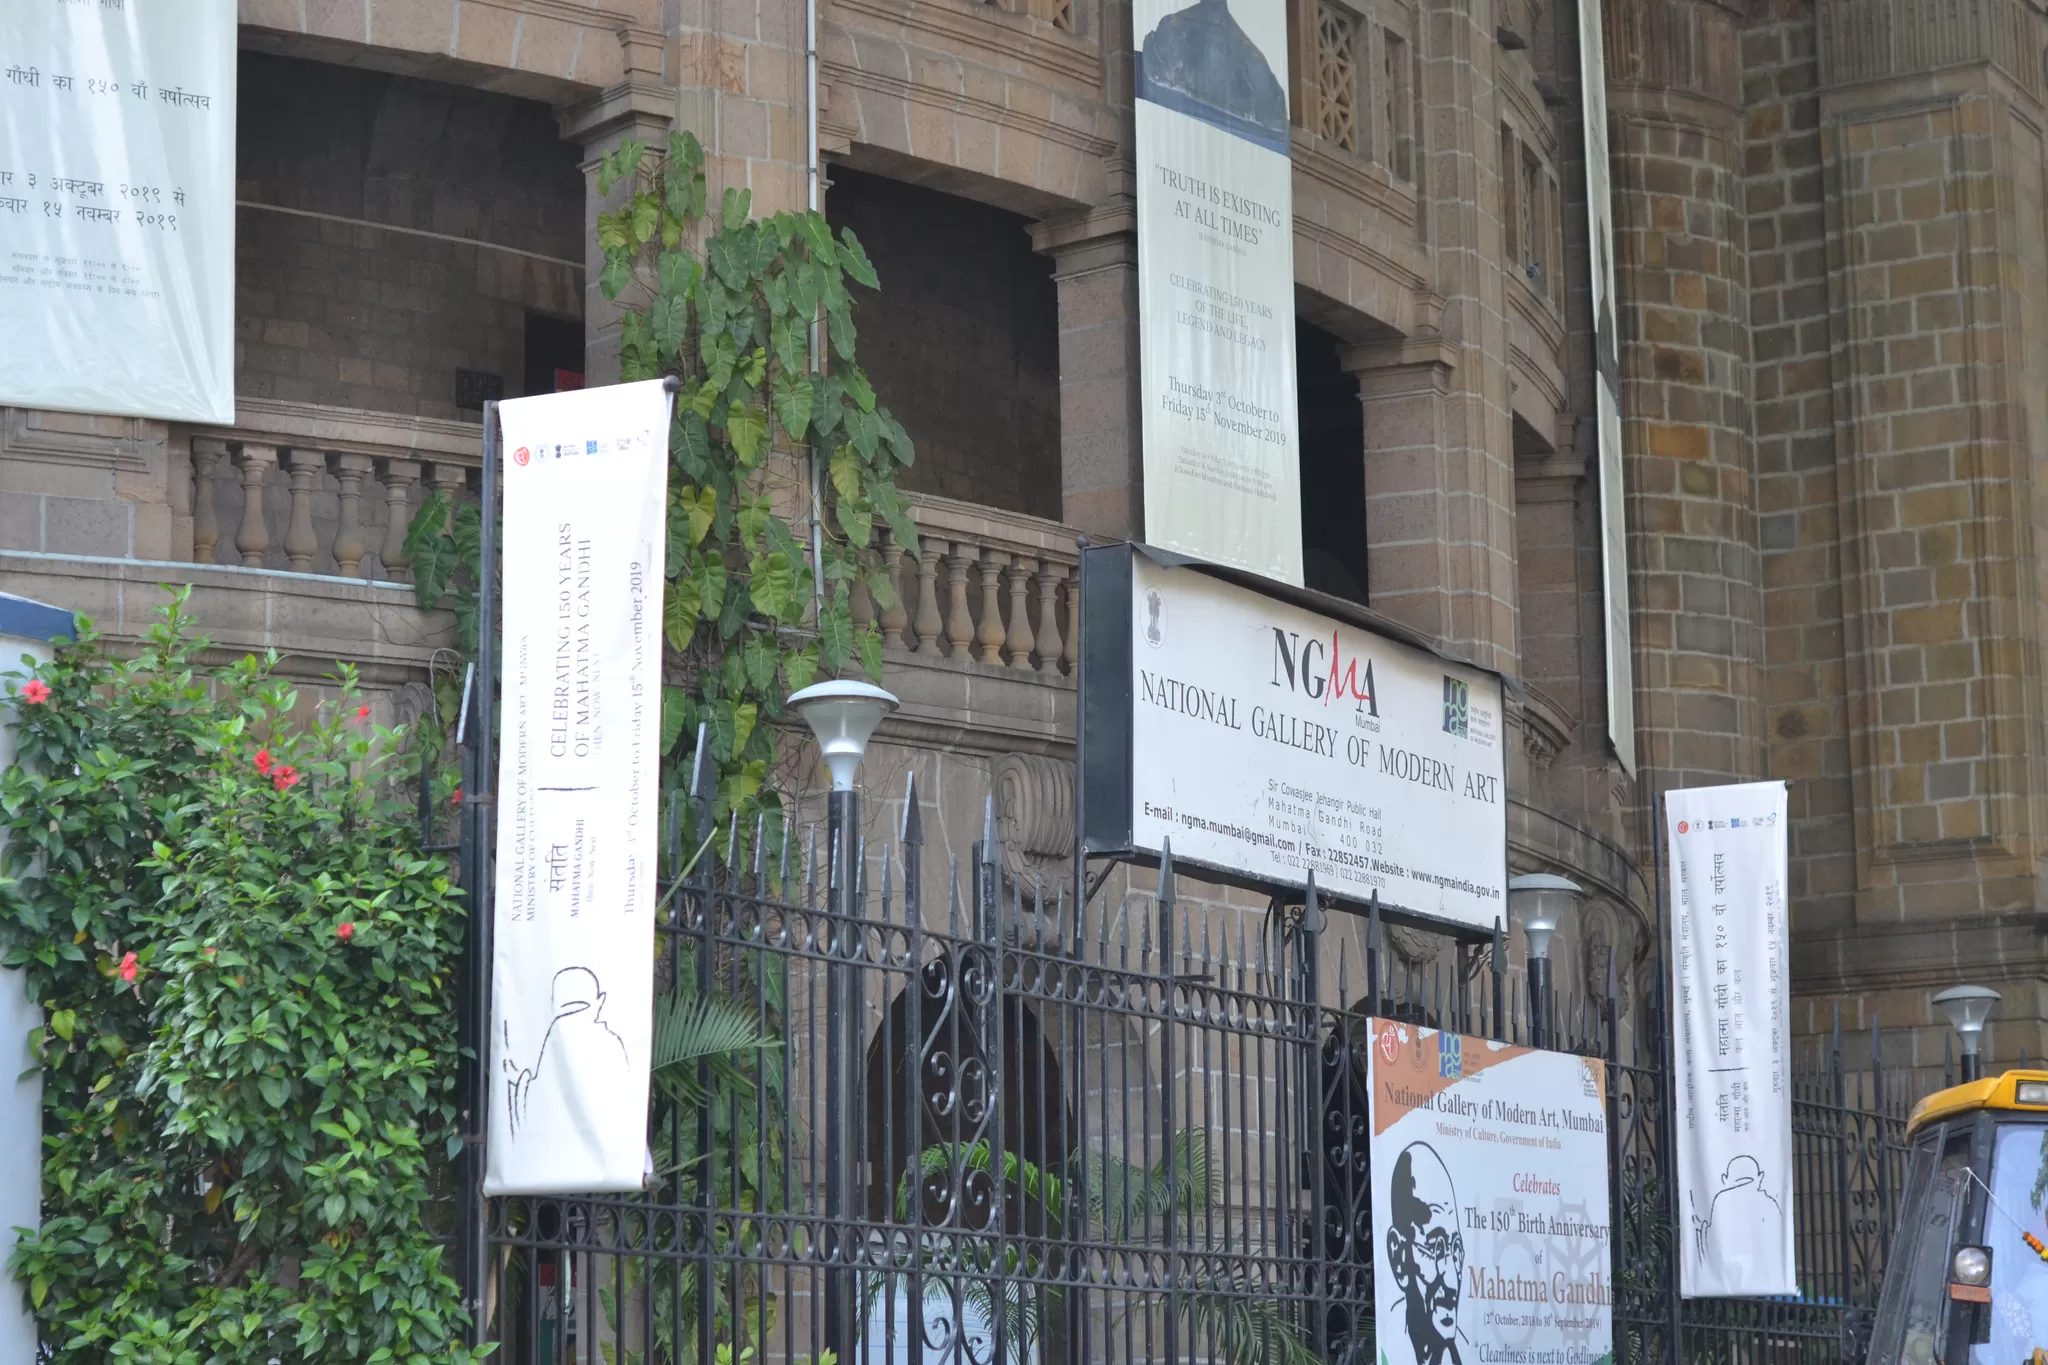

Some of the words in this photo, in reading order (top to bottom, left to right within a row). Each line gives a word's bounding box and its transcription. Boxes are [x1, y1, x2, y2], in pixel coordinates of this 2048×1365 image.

[52, 75, 73, 92] का
[88, 78, 119, 96] १५०
[131, 80, 149, 100] वाँ
[28, 172, 37, 190] ३
[50, 177, 105, 199] अक्टूबर
[120, 183, 161, 204] २०१९
[173, 187, 186, 208] से
[1209, 184, 1220, 205] IS
[1223, 190, 1281, 228] EXISTING
[43, 200, 62, 218] १५
[76, 205, 121, 225] नवम्बर
[136, 210, 177, 231] २०१९
[1174, 200, 1191, 219] AT
[1194, 207, 1218, 231] ALL
[1169, 273, 1229, 304] CELEBRATING
[1229, 294, 1244, 309] 150
[1245, 299, 1273, 320] YEARS
[1195, 300, 1207, 313] OF
[1209, 304, 1226, 321] THE
[1176, 310, 1213, 333] LEGEND
[1214, 324, 1233, 341] AND
[1233, 332, 1267, 352] LEGACY
[1168, 376, 1213, 406] Thursday
[1228, 395, 1268, 420] October
[1269, 410, 1280, 423] to
[1162, 394, 1193, 421] Friday
[1213, 411, 1262, 440] November
[1265, 428, 1287, 446] 2019
[558, 523, 572, 586] YEARS
[577, 540, 591, 618] GANDHI
[629, 561, 643, 594] 2019
[558, 591, 571, 619] 150
[630, 598, 643, 672] November
[550, 626, 571, 758] CELEBRATING
[576, 623, 590, 725] MAHATMA
[631, 700, 642, 747] Friday
[1140, 669, 1241, 730] NATIONAL
[1252, 705, 1338, 758] GALLERY
[1347, 734, 1370, 768] OF
[1379, 744, 1455, 793] MODERN
[1463, 770, 1497, 804] ART
[1355, 714, 1381, 733] Mumbai
[517, 721, 528, 775] MODERN
[574, 731, 590, 757] OF
[631, 749, 641, 765] to
[517, 778, 527, 796] OF
[628, 767, 640, 826] October
[1268, 778, 1278, 792] Sir
[1281, 782, 1312, 803] Cowasjee
[1316, 792, 1343, 811] Jehangir
[1347, 800, 1366, 816] Public
[1369, 807, 1382, 820] Hall
[515, 800, 527, 855] GALLERY
[1268, 797, 1310, 819] Mahatma
[1318, 809, 1352, 829] Gandhi
[1360, 821, 1382, 837] Road
[1268, 815, 1306, 835] Mumbai
[1340, 834, 1357, 848] 400
[1366, 840, 1382, 855] 032
[528, 844, 536, 861] OF
[573, 819, 585, 861] GANDHI
[1145, 801, 1172, 822] E-mail
[1181, 812, 1295, 852] ngma.mumbai@gmail.com
[1305, 842, 1321, 858] Fax
[1411, 868, 1500, 899] www.ngmaindia.gov.in
[544, 843, 569, 893] संतति
[624, 853, 637, 916] Thursday
[1271, 850, 1281, 862] Tel
[1287, 855, 1300, 868] 022
[1340, 868, 1353, 881] 022
[1354, 869, 1386, 889] 22881970
[511, 860, 526, 922] NATIONAL
[526, 865, 536, 922] MINISTRY
[570, 863, 583, 918] MAHATMA
[1715, 924, 1728, 949] १५०
[1715, 959, 1728, 975] का
[1733, 969, 1743, 985] कल
[1731, 991, 1744, 1005] और
[1718, 1018, 1731, 1056] महात्मा
[1733, 1012, 1744, 1031] आज
[1733, 1038, 1744, 1054] कल
[1384, 1081, 1434, 1111] National
[1437, 1091, 1479, 1123] Gallery
[1482, 1099, 1494, 1118] of
[1495, 1100, 1536, 1126] Modern
[1540, 1107, 1560, 1130] Art,
[1562, 1109, 1604, 1134] Mumbai
[1714, 1093, 1730, 1123] संतति
[1734, 1106, 1742, 1133] महात्मा
[1435, 1121, 1464, 1141] Ministry
[1465, 1126, 1472, 1139] of
[1473, 1127, 1499, 1143] Culture,
[1500, 1133, 1538, 1148] Government
[1538, 1135, 1546, 1148] of
[1546, 1134, 1561, 1150] India
[1512, 1172, 1561, 1196] Celebrates
[1465, 1206, 1487, 1228] The
[1518, 1212, 1546, 1235] Birth
[1548, 1215, 1610, 1245] Anniversary
[1534, 1250, 1543, 1264] of
[1468, 1265, 1548, 1303] Mahatma
[1552, 1271, 1612, 1306] Gandhi
[1521, 1315, 1536, 1327] 2018
[1536, 1316, 1543, 1327] to
[1529, 1347, 1536, 1364] is
[1537, 1348, 1555, 1365] next
[1556, 1350, 1565, 1365] to
